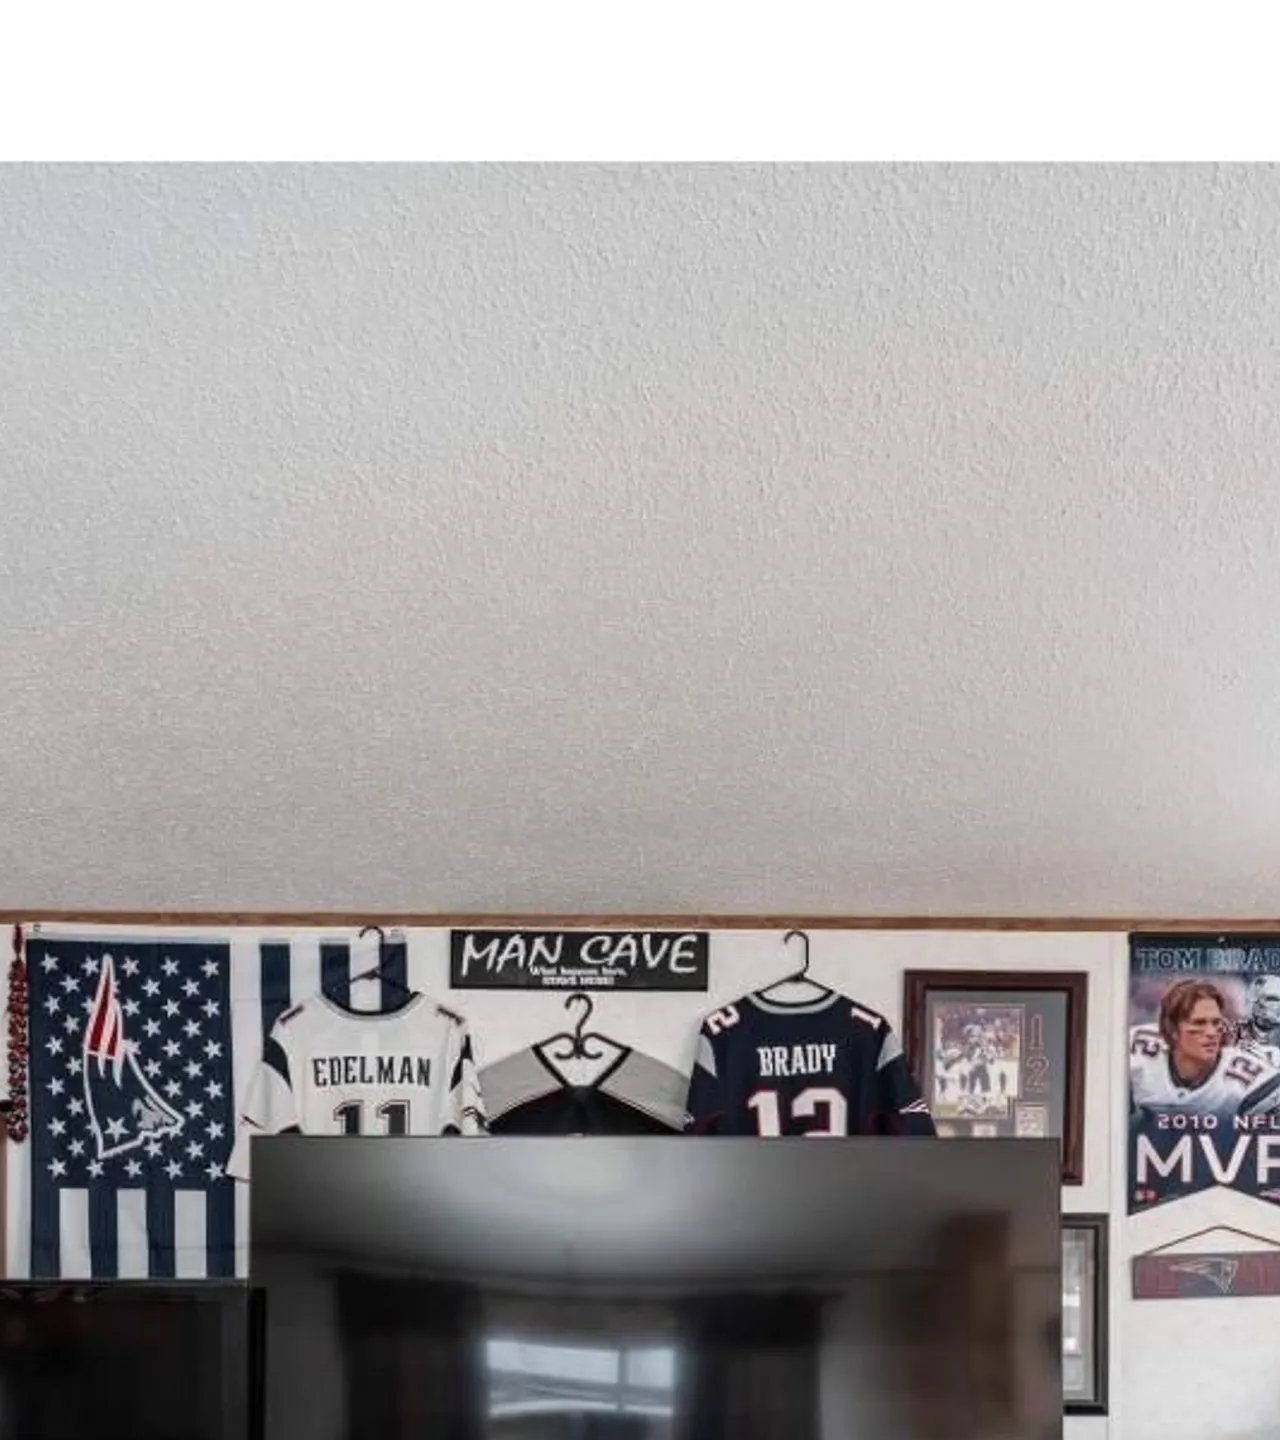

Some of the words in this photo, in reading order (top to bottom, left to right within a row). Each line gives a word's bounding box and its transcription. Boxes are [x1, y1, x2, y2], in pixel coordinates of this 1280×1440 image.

[461, 933, 564, 977] MAN
[579, 933, 699, 974] CAVE
[1136, 948, 1202, 970] TOM
[312, 1055, 432, 1087] EDELMAN
[756, 1043, 837, 1077] BRADY
[1157, 1113, 1219, 1130] 2010
